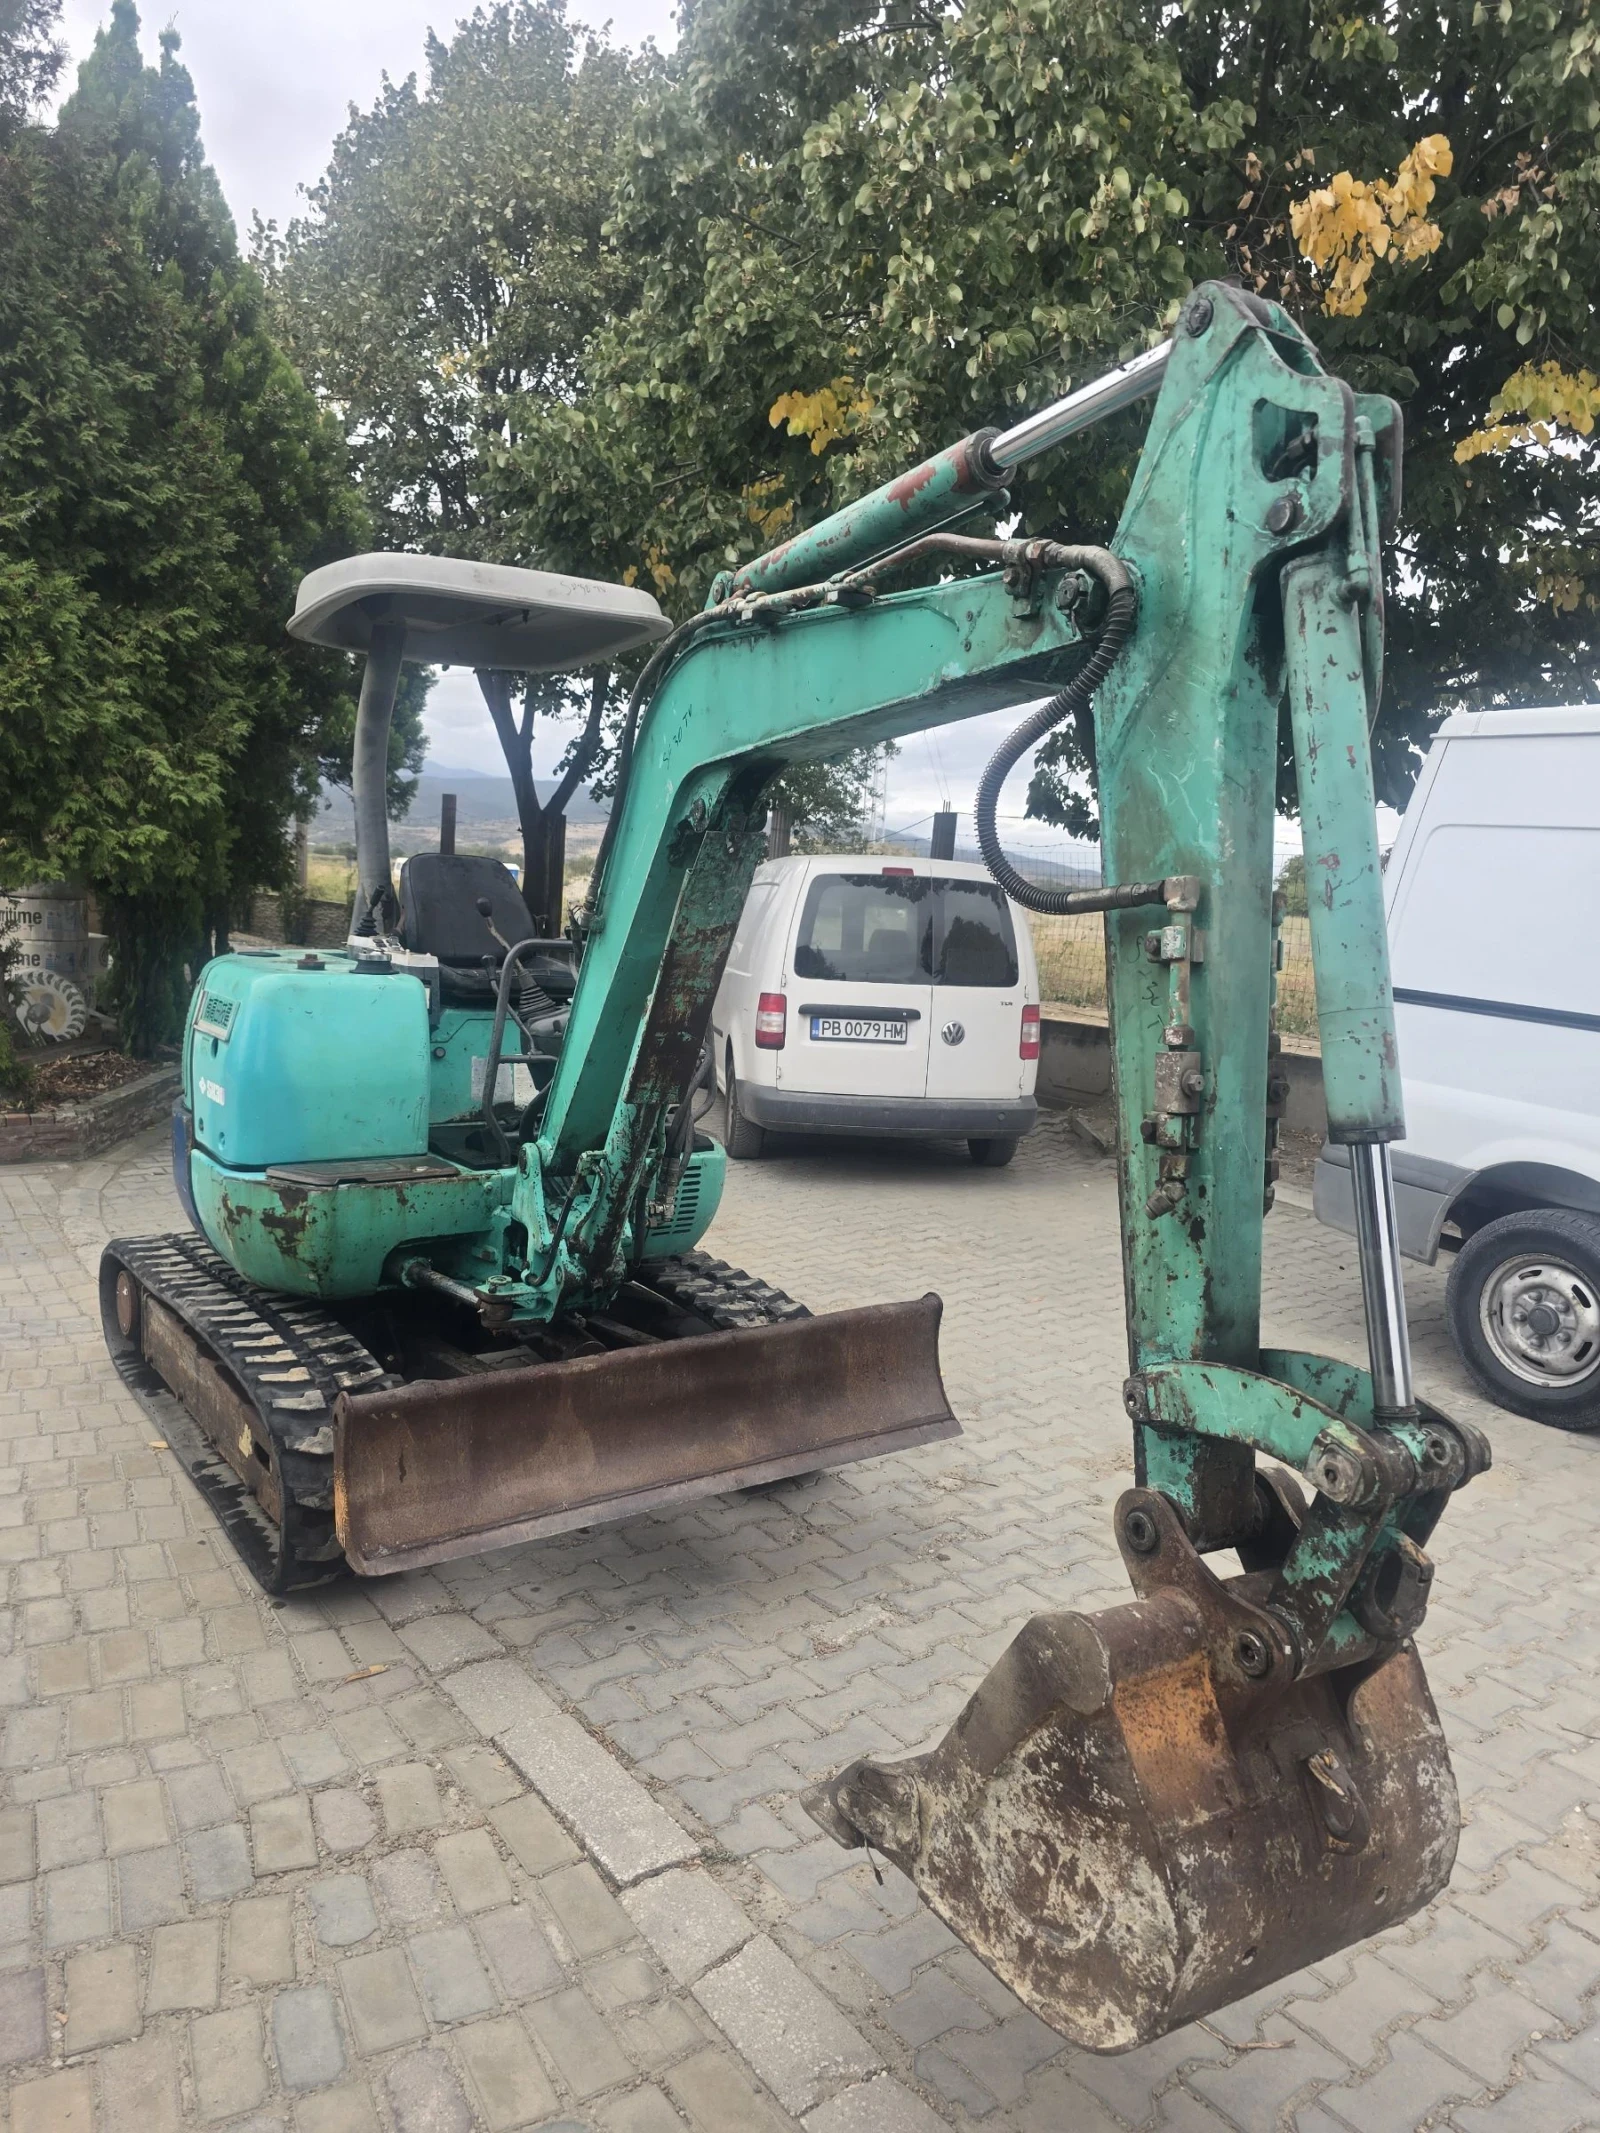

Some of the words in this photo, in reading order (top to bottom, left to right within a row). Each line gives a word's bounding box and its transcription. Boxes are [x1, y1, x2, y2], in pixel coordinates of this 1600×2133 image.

[821, 1020, 841, 1036] PB
[844, 1021, 881, 1038] 0079
[884, 1023, 904, 1039] HM
